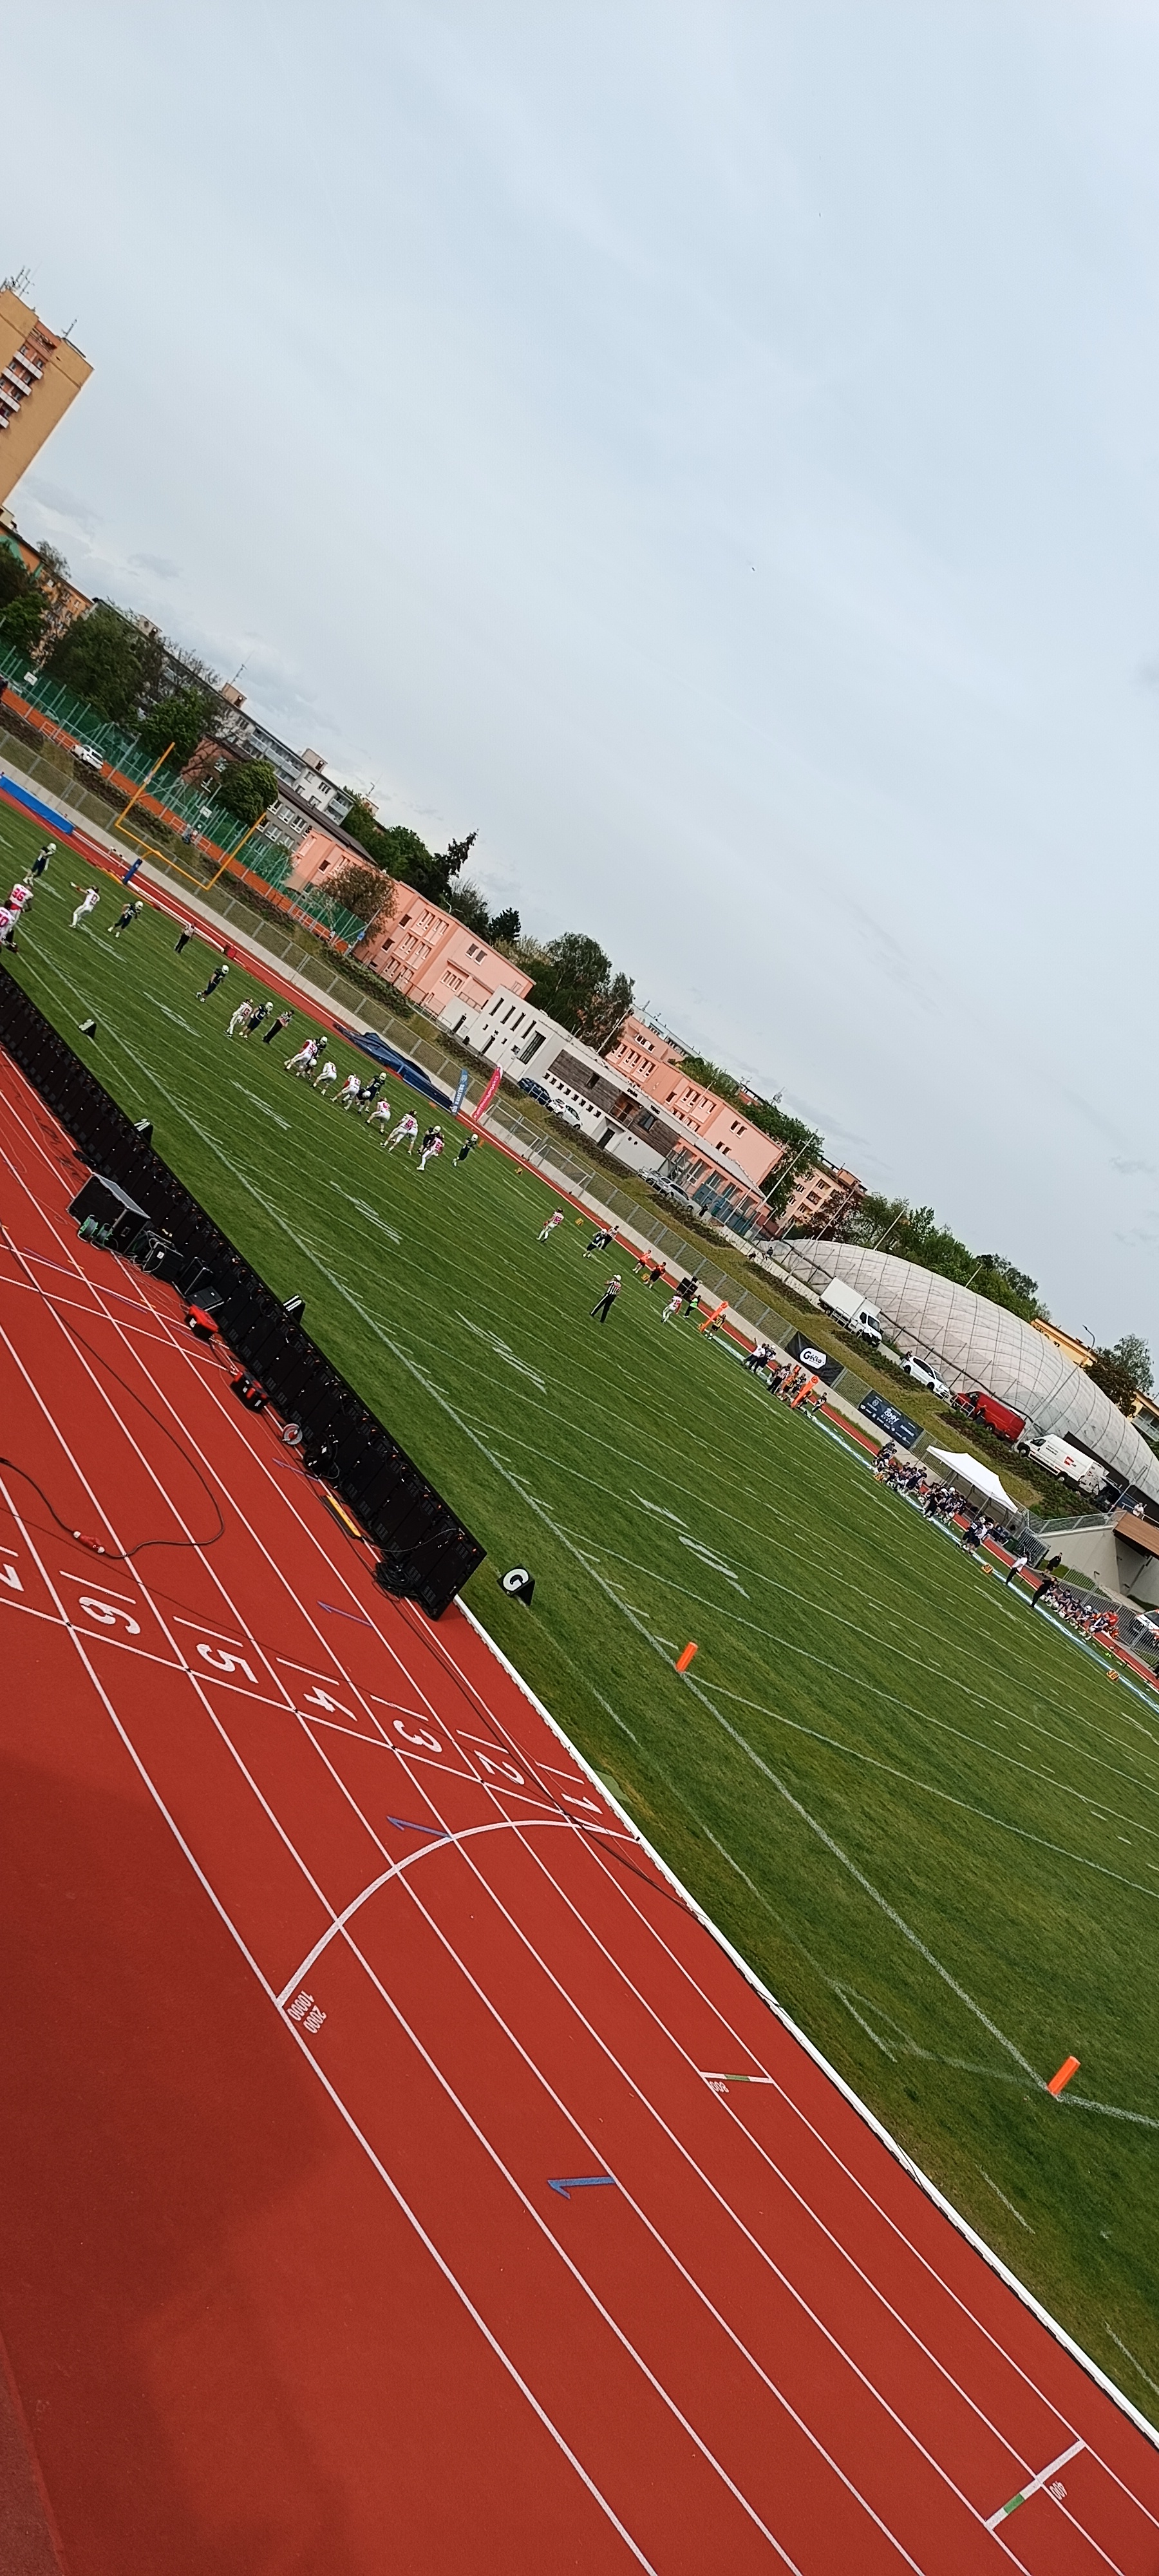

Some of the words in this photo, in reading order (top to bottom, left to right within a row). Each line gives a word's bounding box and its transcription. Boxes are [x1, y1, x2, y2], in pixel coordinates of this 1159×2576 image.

[502, 1568, 529, 1591] G
[78, 1596, 140, 1634] 6
[196, 1643, 259, 1684] 5
[303, 1685, 358, 1721] 4
[393, 1719, 442, 1753] 3
[474, 1750, 525, 1785] 2
[561, 1793, 603, 1815] 1
[286, 1990, 314, 2022] 10000
[303, 2005, 327, 2034] 2000
[710, 2080, 730, 2093] 800
[1049, 2481, 1068, 2500] 400
